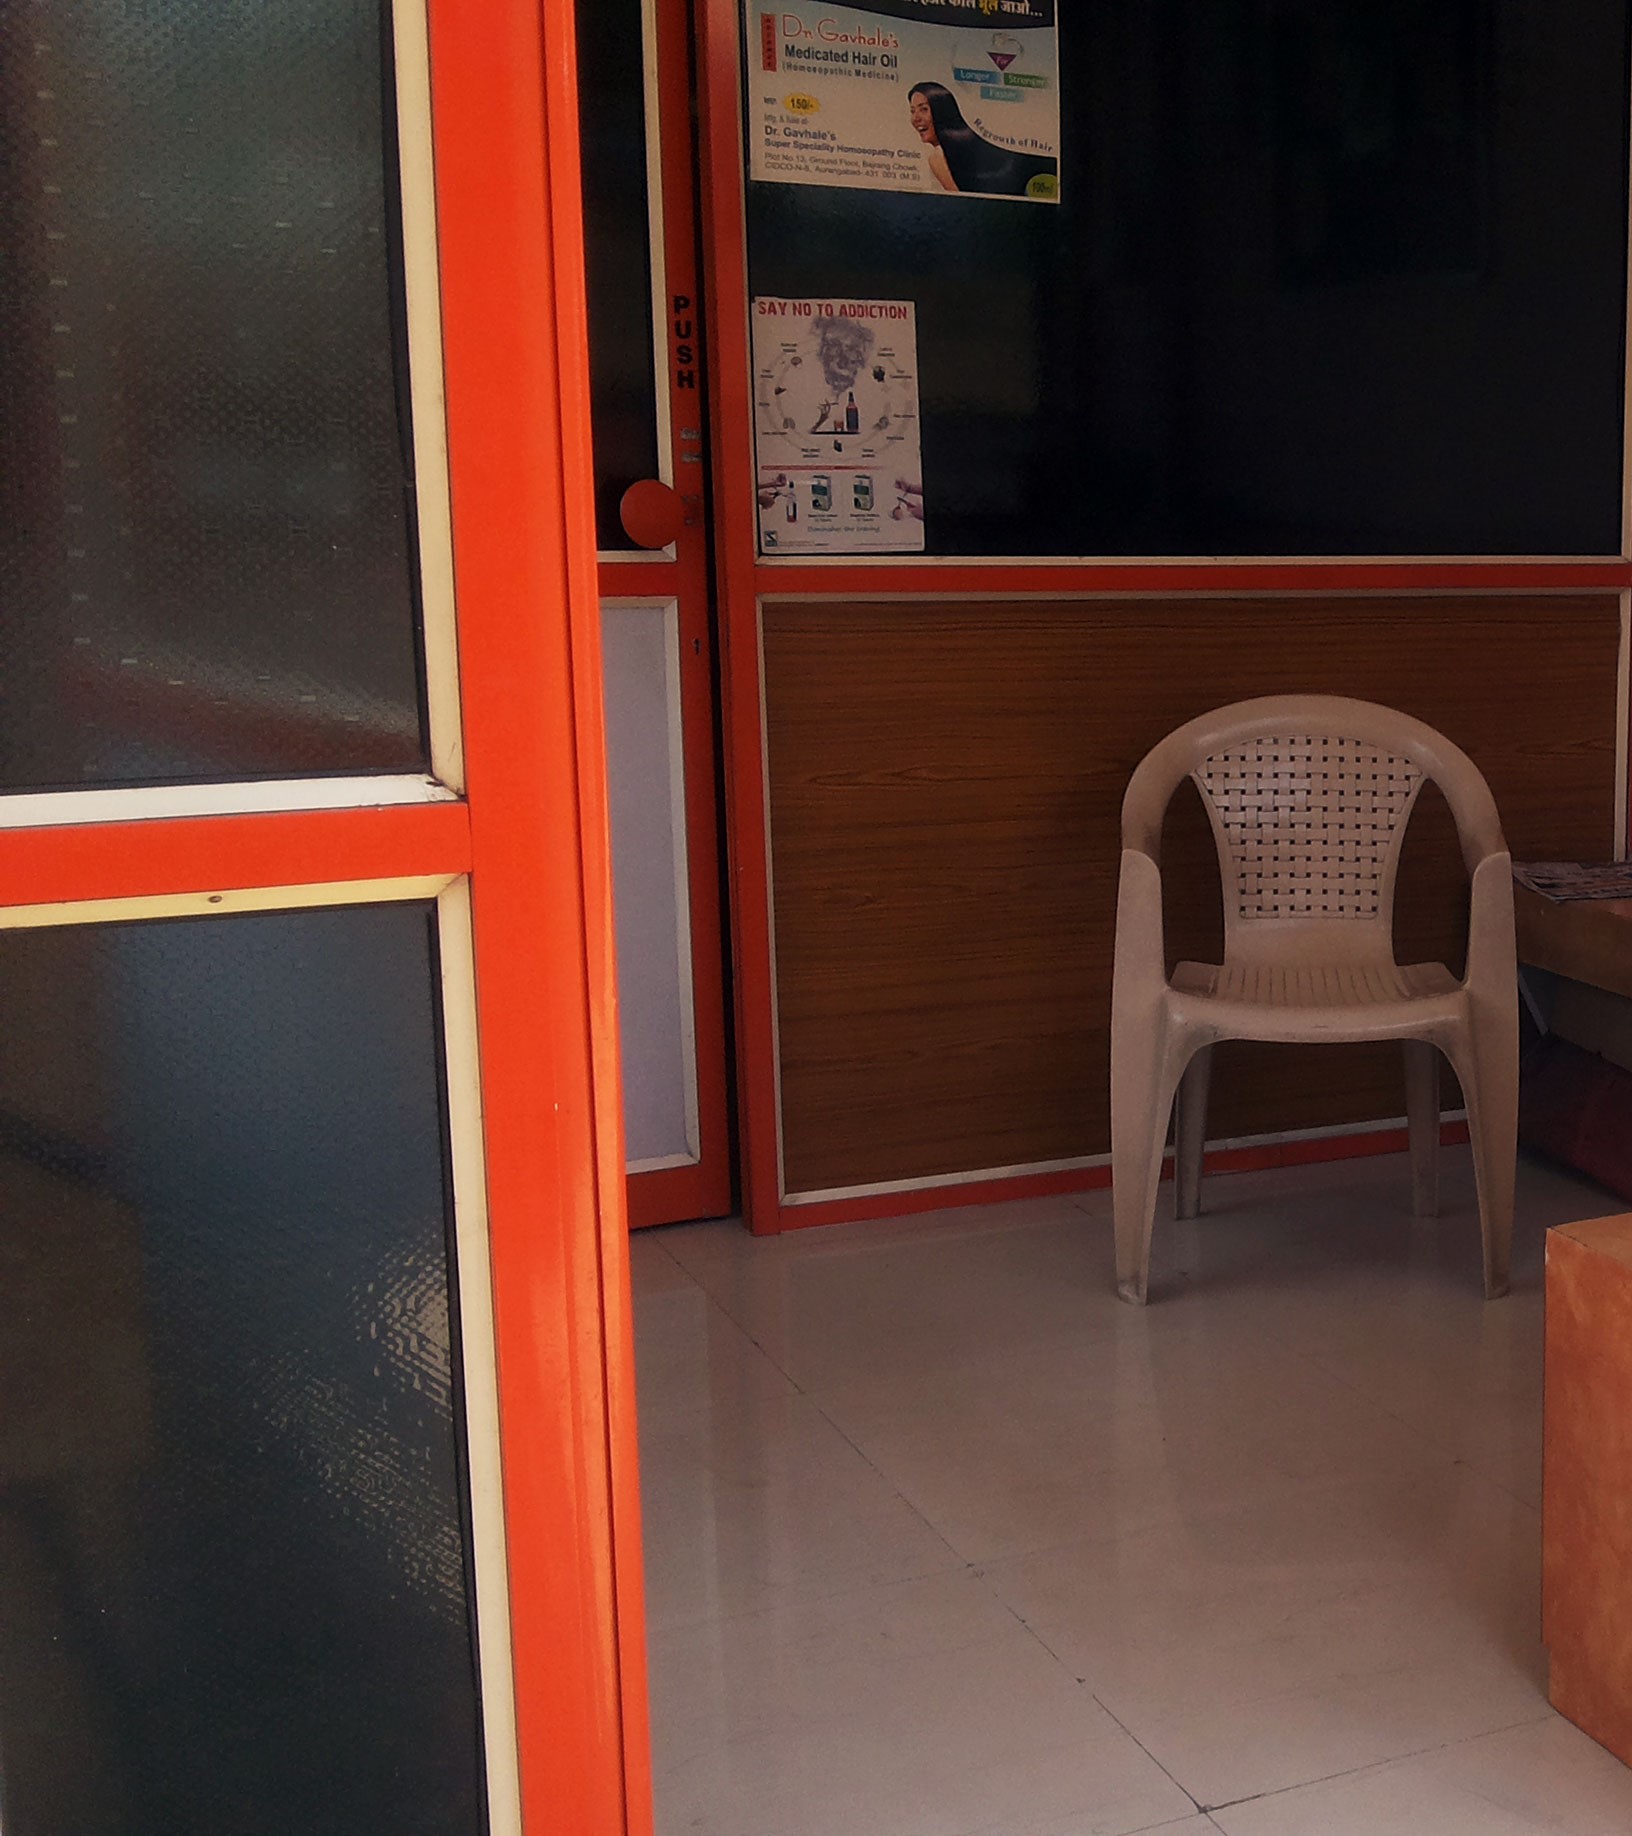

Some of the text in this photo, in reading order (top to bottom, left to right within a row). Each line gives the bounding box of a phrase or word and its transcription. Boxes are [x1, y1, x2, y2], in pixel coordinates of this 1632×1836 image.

[817, 18, 899, 48] Gavhale's
[785, 44, 898, 68] Medicated Hair Oil
[764, 125, 837, 141] Dr. Gavhale's
[973, 118, 1016, 145] Regrowth
[1030, 139, 1053, 152] Hair
[764, 139, 790, 149] Super
[793, 141, 835, 153] Speciality
[897, 149, 921, 159] Clinic
[758, 301, 908, 320] SAY NO TO ADDICTION
[672, 295, 695, 390] PUSH
